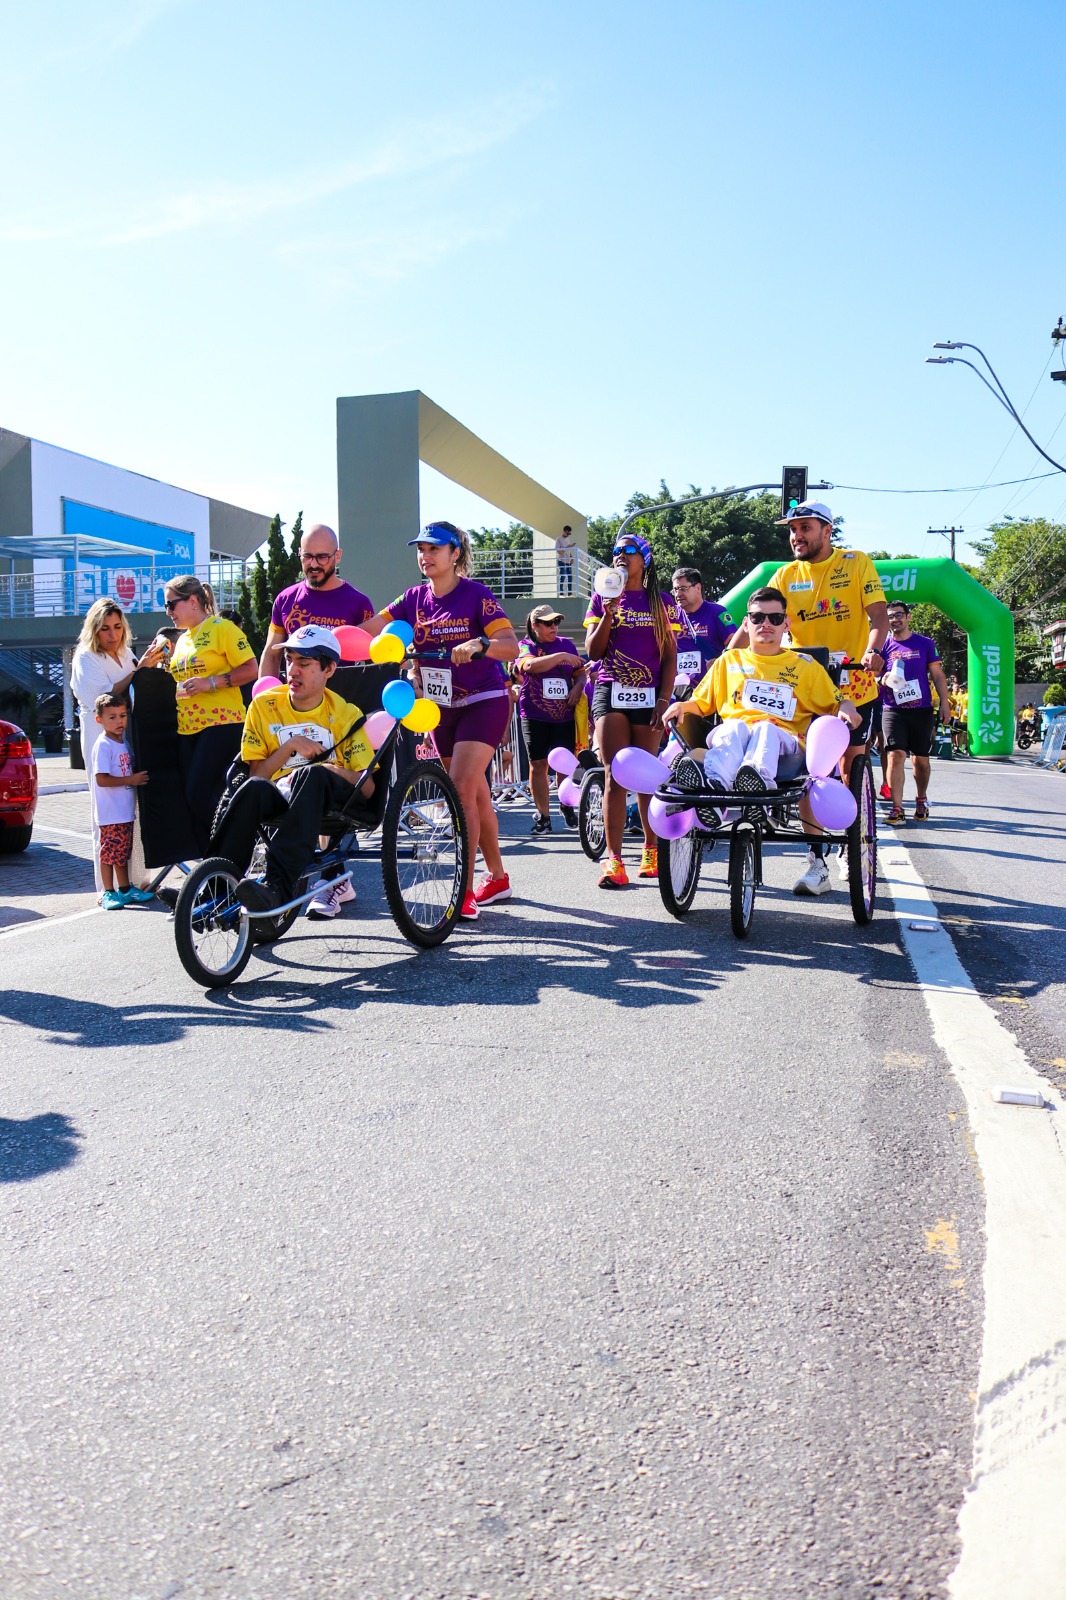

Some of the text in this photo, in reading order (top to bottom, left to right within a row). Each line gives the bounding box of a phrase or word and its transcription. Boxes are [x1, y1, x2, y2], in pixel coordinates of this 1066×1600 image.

[174, 543, 191, 560] POÁ
[309, 616, 347, 626] PERNAS
[432, 617, 470, 628] PERNAS
[440, 632, 471, 641] SUZANO
[678, 661, 698, 669] 6229
[982, 645, 1000, 716] Sicredi
[427, 683, 449, 697] 6274
[548, 687, 565, 695] 6101
[897, 688, 916, 700] 6146
[617, 692, 647, 702] 6239
[749, 694, 785, 710] 6223
